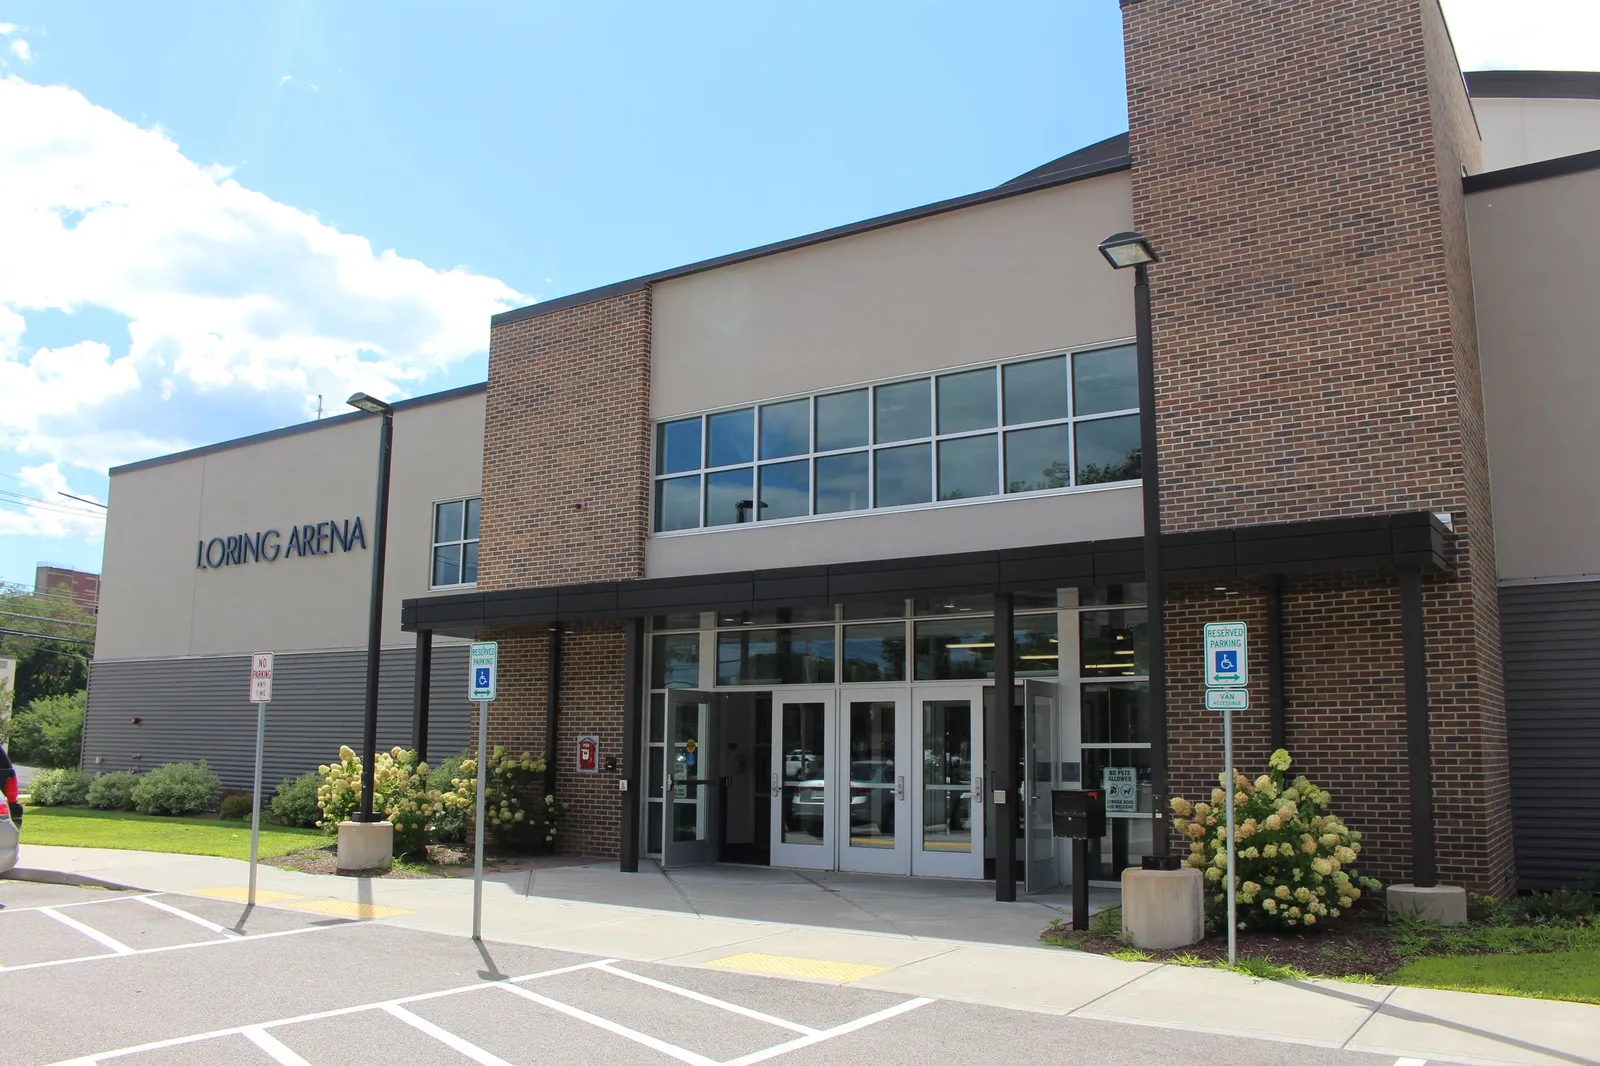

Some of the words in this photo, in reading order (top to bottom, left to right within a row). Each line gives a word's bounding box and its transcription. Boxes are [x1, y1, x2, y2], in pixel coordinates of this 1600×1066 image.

[196, 529, 280, 569] LORING
[284, 516, 367, 559] ARENA
[1207, 628, 1243, 638] RESERVED
[1210, 639, 1242, 648] PARKING
[471, 647, 495, 656] RESERVED
[258, 658, 267, 668] NO
[472, 658, 494, 666] PARKING
[253, 670, 271, 679] PARKING
